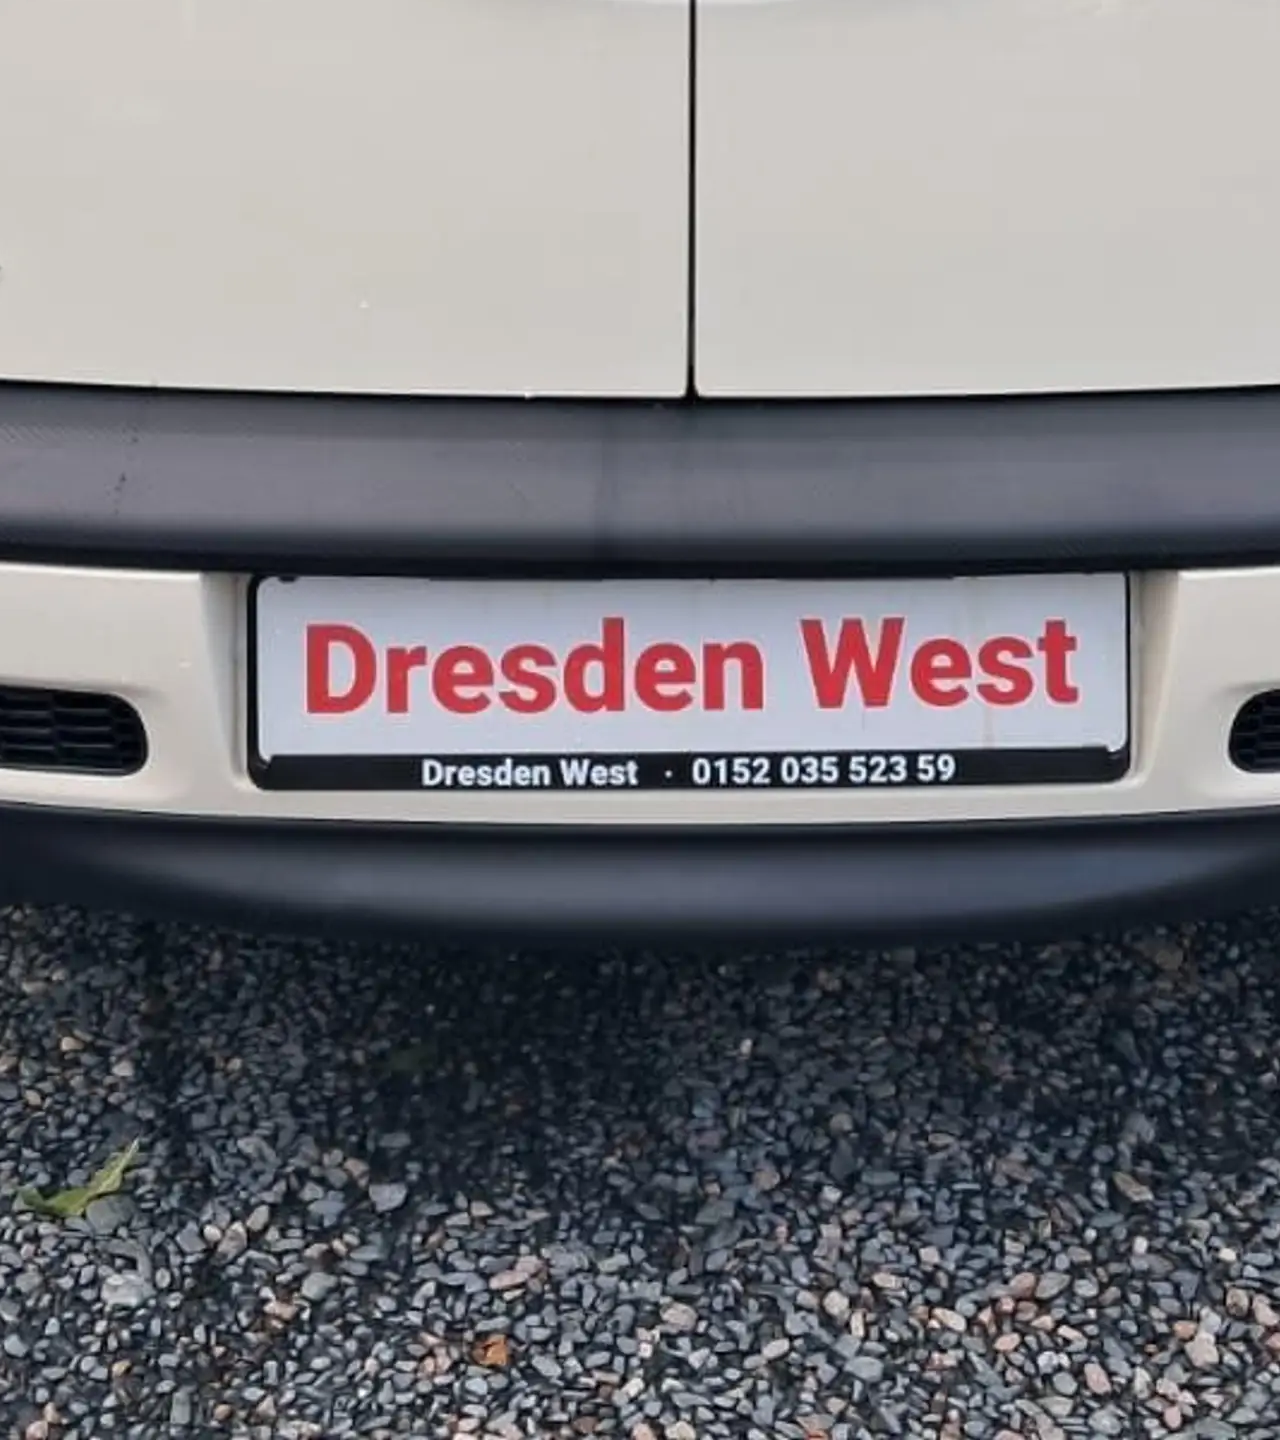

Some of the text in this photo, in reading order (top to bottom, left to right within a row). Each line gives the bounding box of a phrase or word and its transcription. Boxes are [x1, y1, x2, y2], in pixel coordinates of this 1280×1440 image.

[304, 615, 1080, 716] Dresden West
[422, 754, 956, 787] Dresden West 0152 035 523 59
